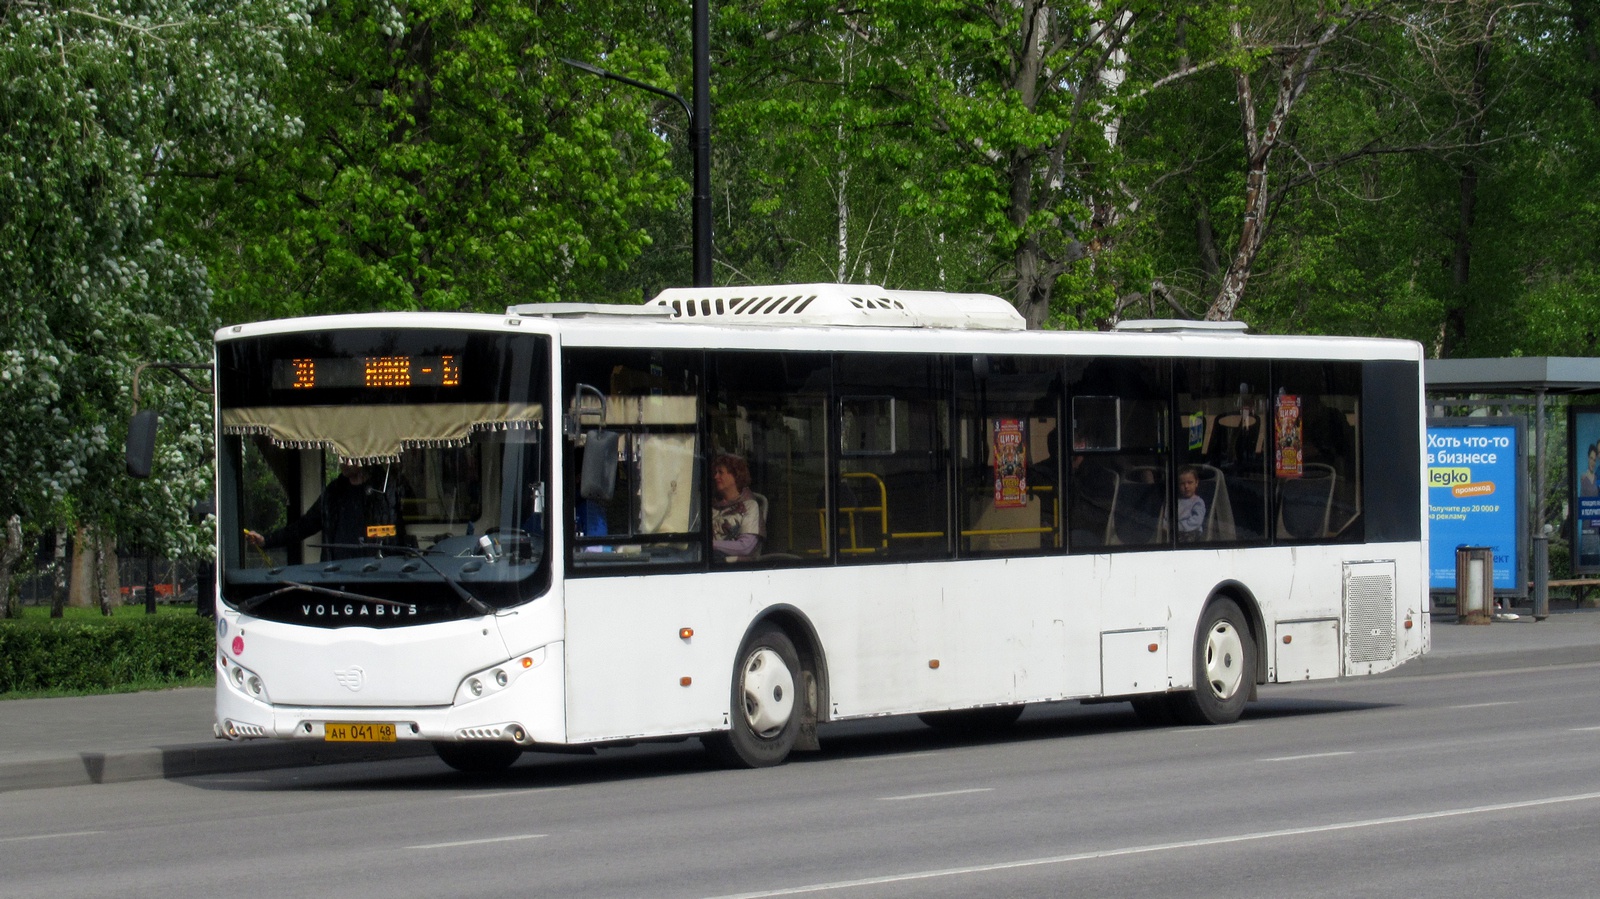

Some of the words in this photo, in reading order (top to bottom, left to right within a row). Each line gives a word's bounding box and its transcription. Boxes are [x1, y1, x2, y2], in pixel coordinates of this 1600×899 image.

[1427, 433, 1461, 448] Хоть
[1463, 436, 1509, 448] что-то
[1427, 453, 1435, 464] в
[1437, 450, 1497, 464] бизнесе
[1430, 469, 1468, 486] legko
[1455, 484, 1492, 495] промокод
[1471, 504, 1481, 513] 20
[1480, 504, 1494, 513] 000
[302, 604, 417, 615] VOLGABUS
[350, 725, 373, 740] 041
[379, 725, 392, 736] 48
